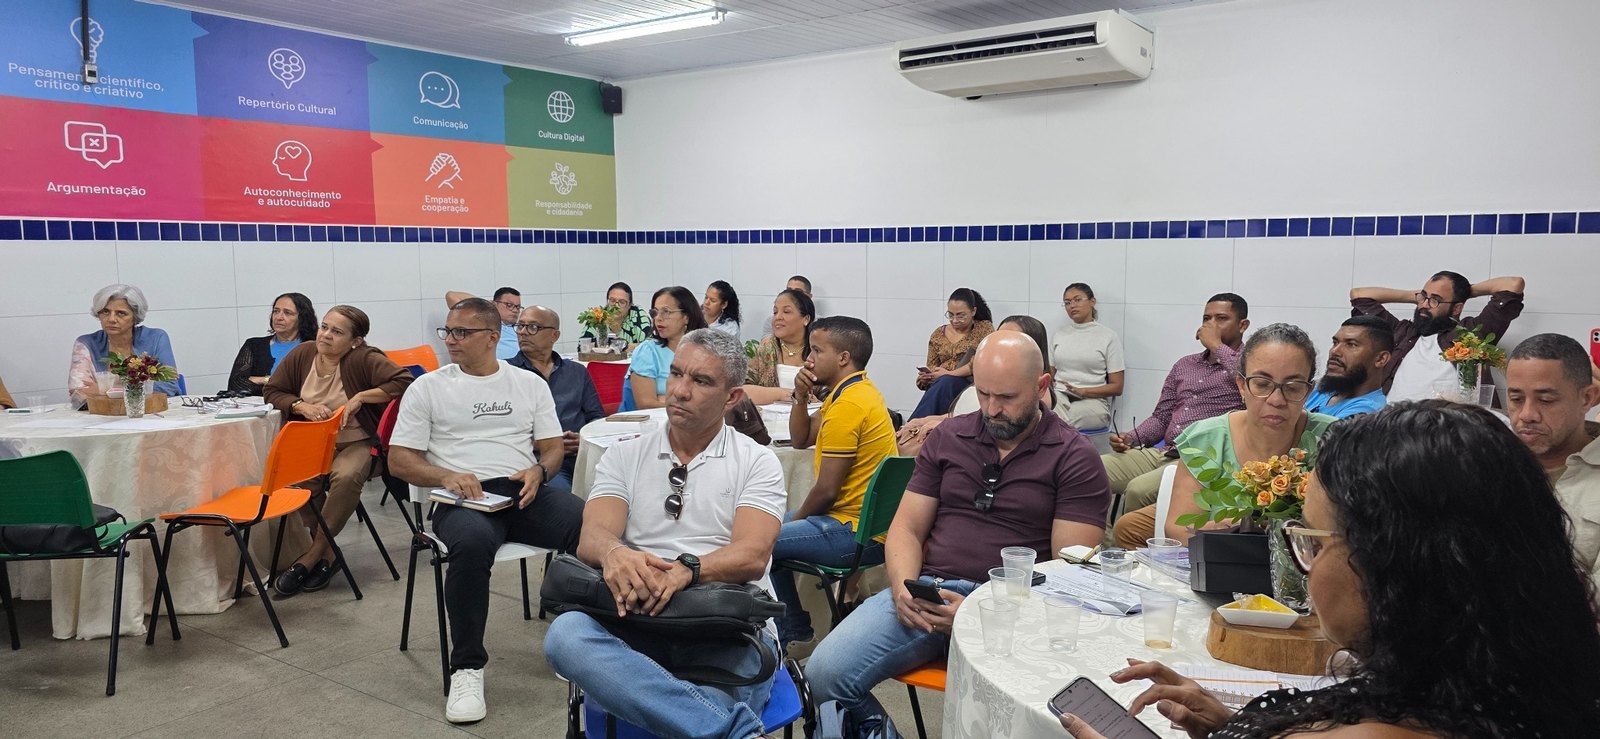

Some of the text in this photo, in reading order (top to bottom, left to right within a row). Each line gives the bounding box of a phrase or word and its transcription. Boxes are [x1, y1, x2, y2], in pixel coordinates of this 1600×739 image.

[8, 62, 165, 92] Pensamen científico,
[34, 78, 144, 99] crítico e criativo
[238, 95, 337, 116] Repertório Cultural
[413, 115, 469, 130] Comunicação
[538, 130, 585, 143] Cultura Digital
[47, 181, 147, 197] Argumentação
[243, 186, 342, 200] Autoconhecimento
[258, 197, 331, 208] e autocuidado
[424, 194, 465, 205] Empatia e
[535, 199, 593, 210] Responsabilidade
[421, 203, 469, 214] cooperação
[551, 208, 584, 216] cidadania
